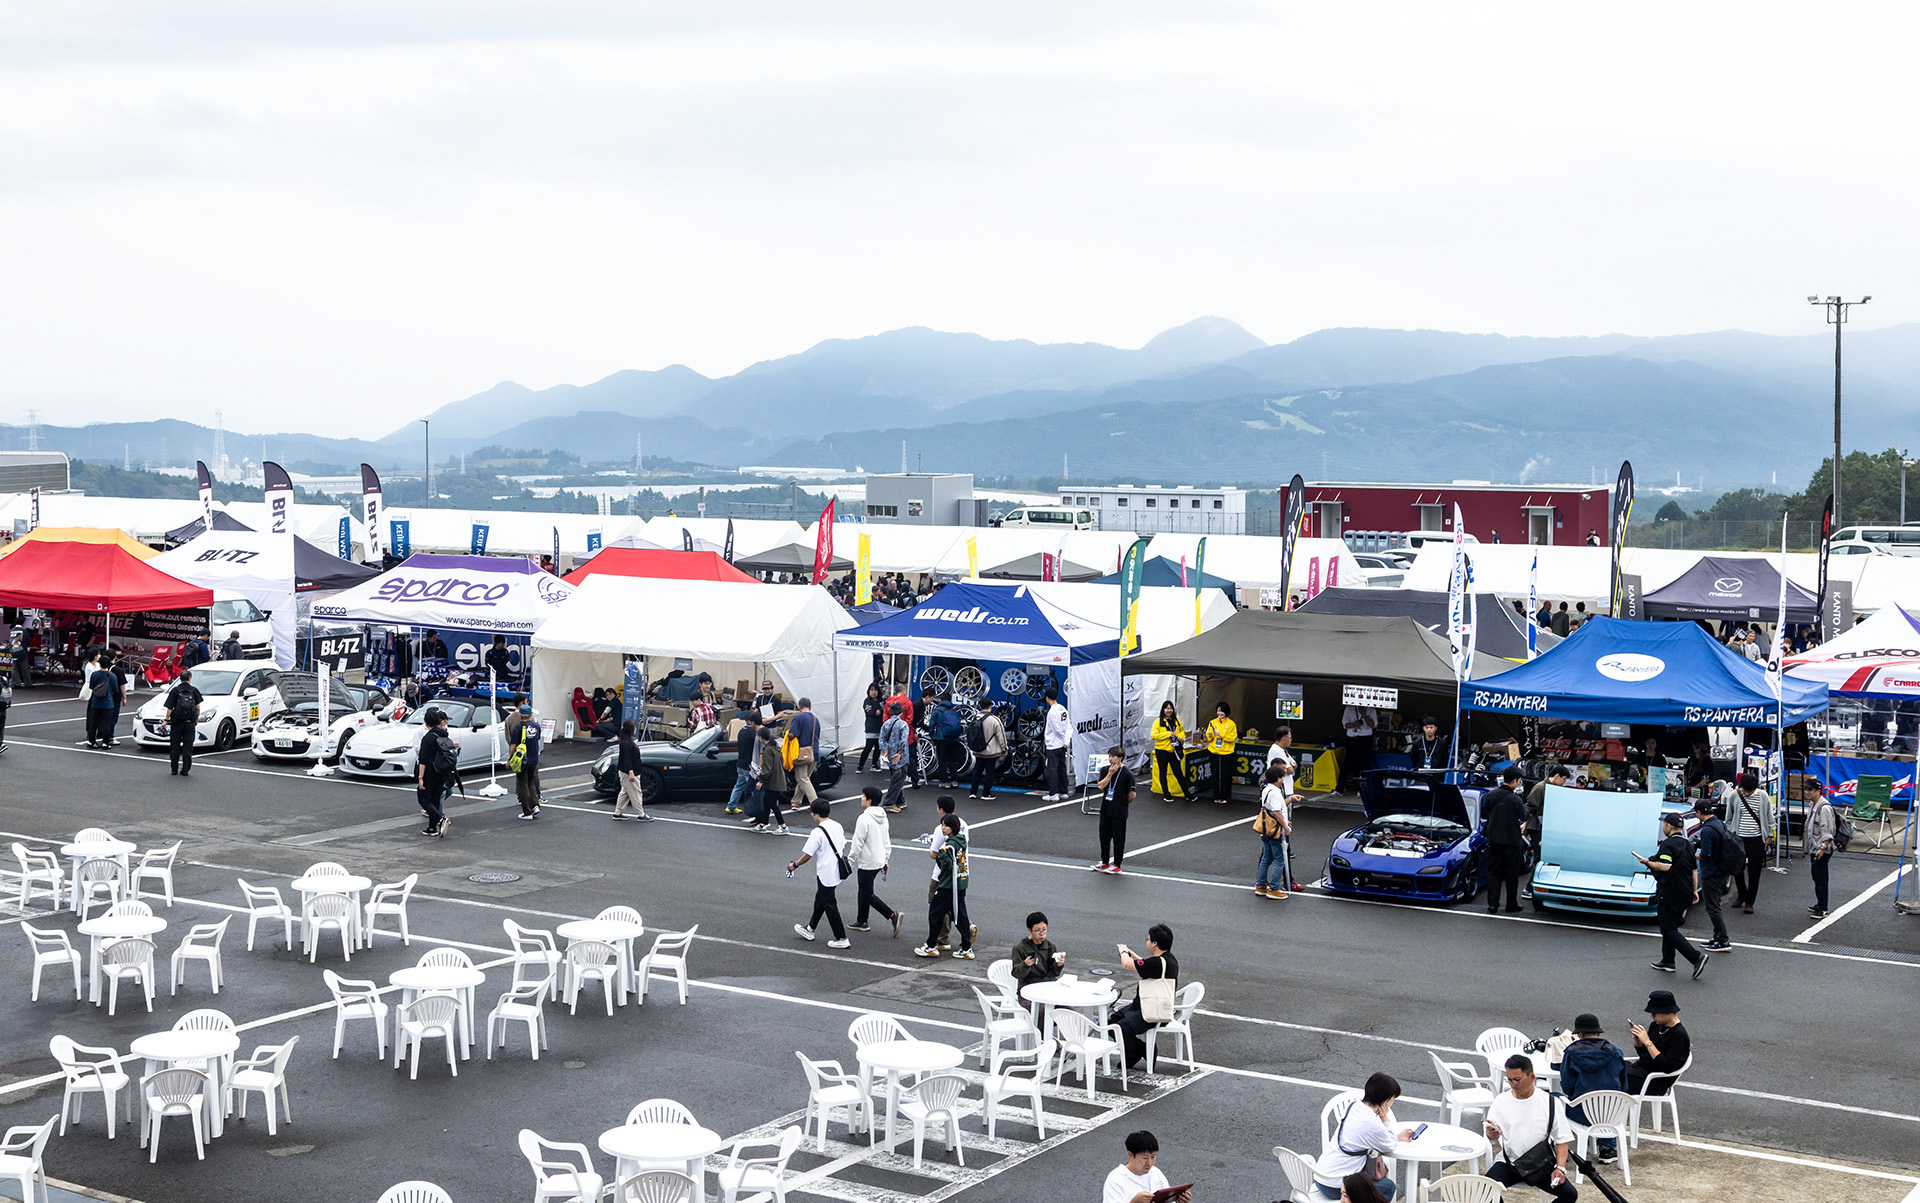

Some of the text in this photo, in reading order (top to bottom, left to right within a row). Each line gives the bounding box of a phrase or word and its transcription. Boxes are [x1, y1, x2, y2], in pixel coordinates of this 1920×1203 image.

[194, 549, 260, 564] BLITZ
[374, 577, 510, 605] sparco
[1628, 584, 1636, 617] KANTO
[1832, 591, 1841, 626] KANTO
[314, 605, 347, 616] sparco
[913, 606, 990, 623] weds
[445, 615, 534, 629] www.sparco-japan.com
[320, 637, 360, 656] BLITZ
[845, 639, 890, 649] www.weds.co.jp
[1834, 648, 1920, 660] CUSCO
[1077, 713, 1103, 735] weds
